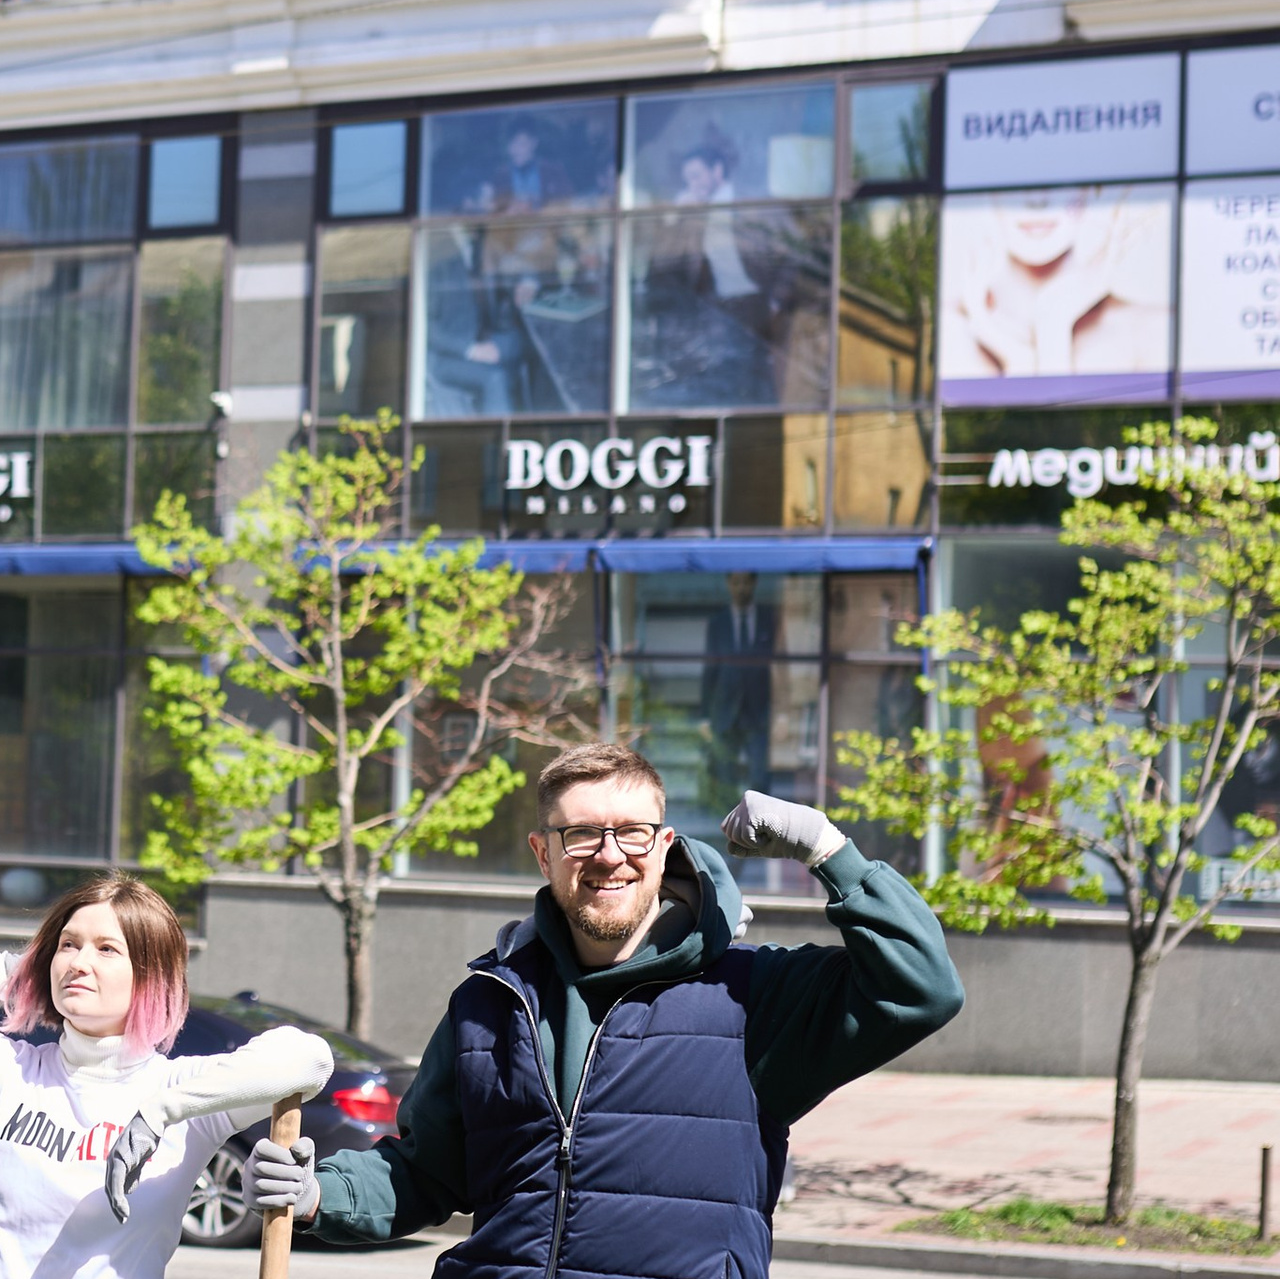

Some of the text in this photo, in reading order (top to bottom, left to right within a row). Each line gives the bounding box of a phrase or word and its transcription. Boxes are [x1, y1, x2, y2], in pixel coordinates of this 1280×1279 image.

[963, 99, 1161, 141] ВИДАЛЕННЯ
[504, 435, 711, 491] BOGGI
[525, 493, 686, 515] MILANO
